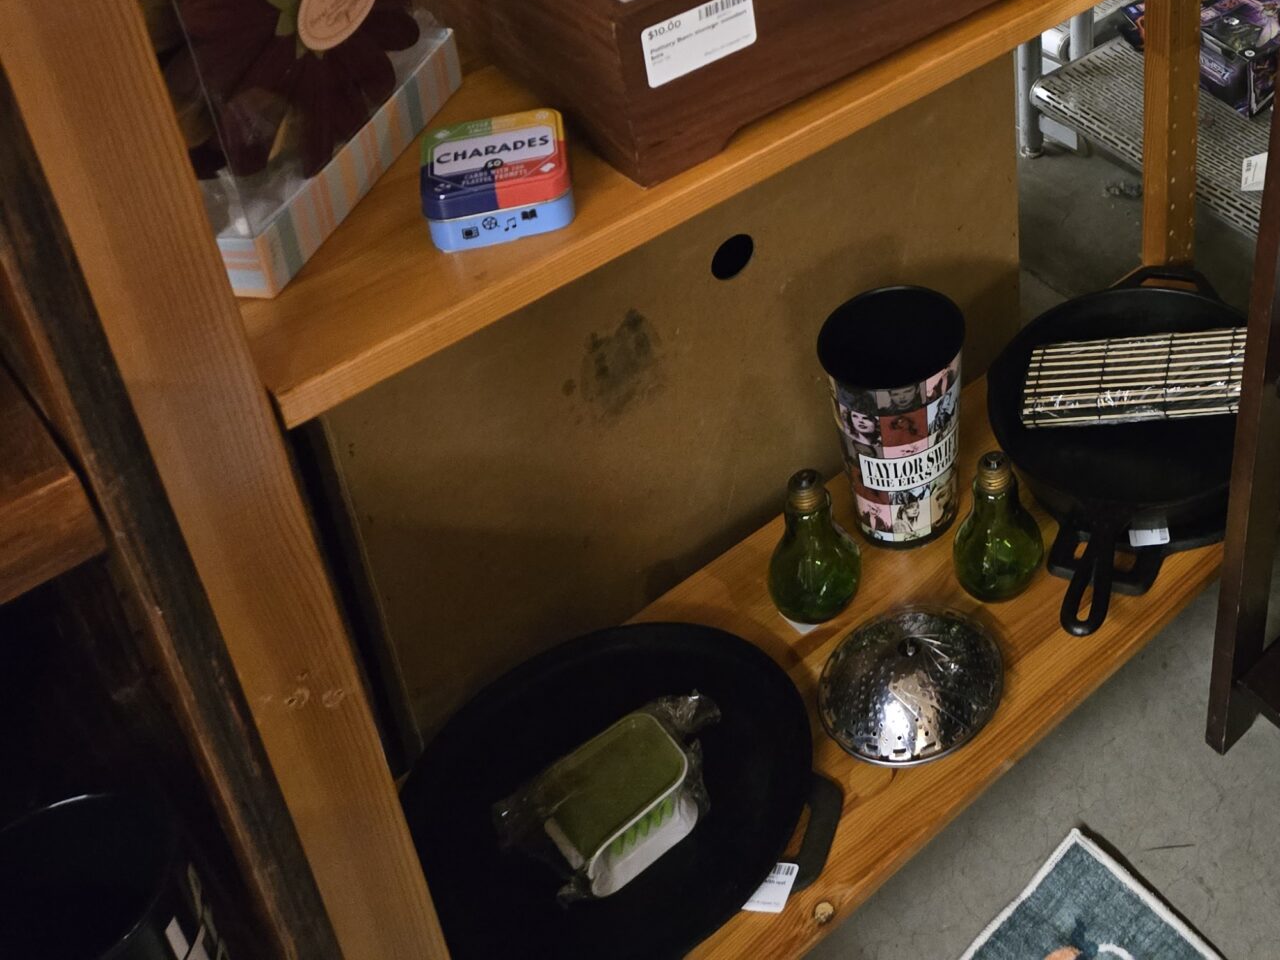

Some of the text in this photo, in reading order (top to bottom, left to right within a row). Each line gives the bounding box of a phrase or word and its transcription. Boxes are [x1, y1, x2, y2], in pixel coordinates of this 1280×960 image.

[648, 20, 682, 40] $10.00
[436, 135, 549, 165] CHARADES
[864, 457, 924, 479] TAYLOR
[867, 476, 895, 487] THE
[898, 471, 932, 487] ERAS
